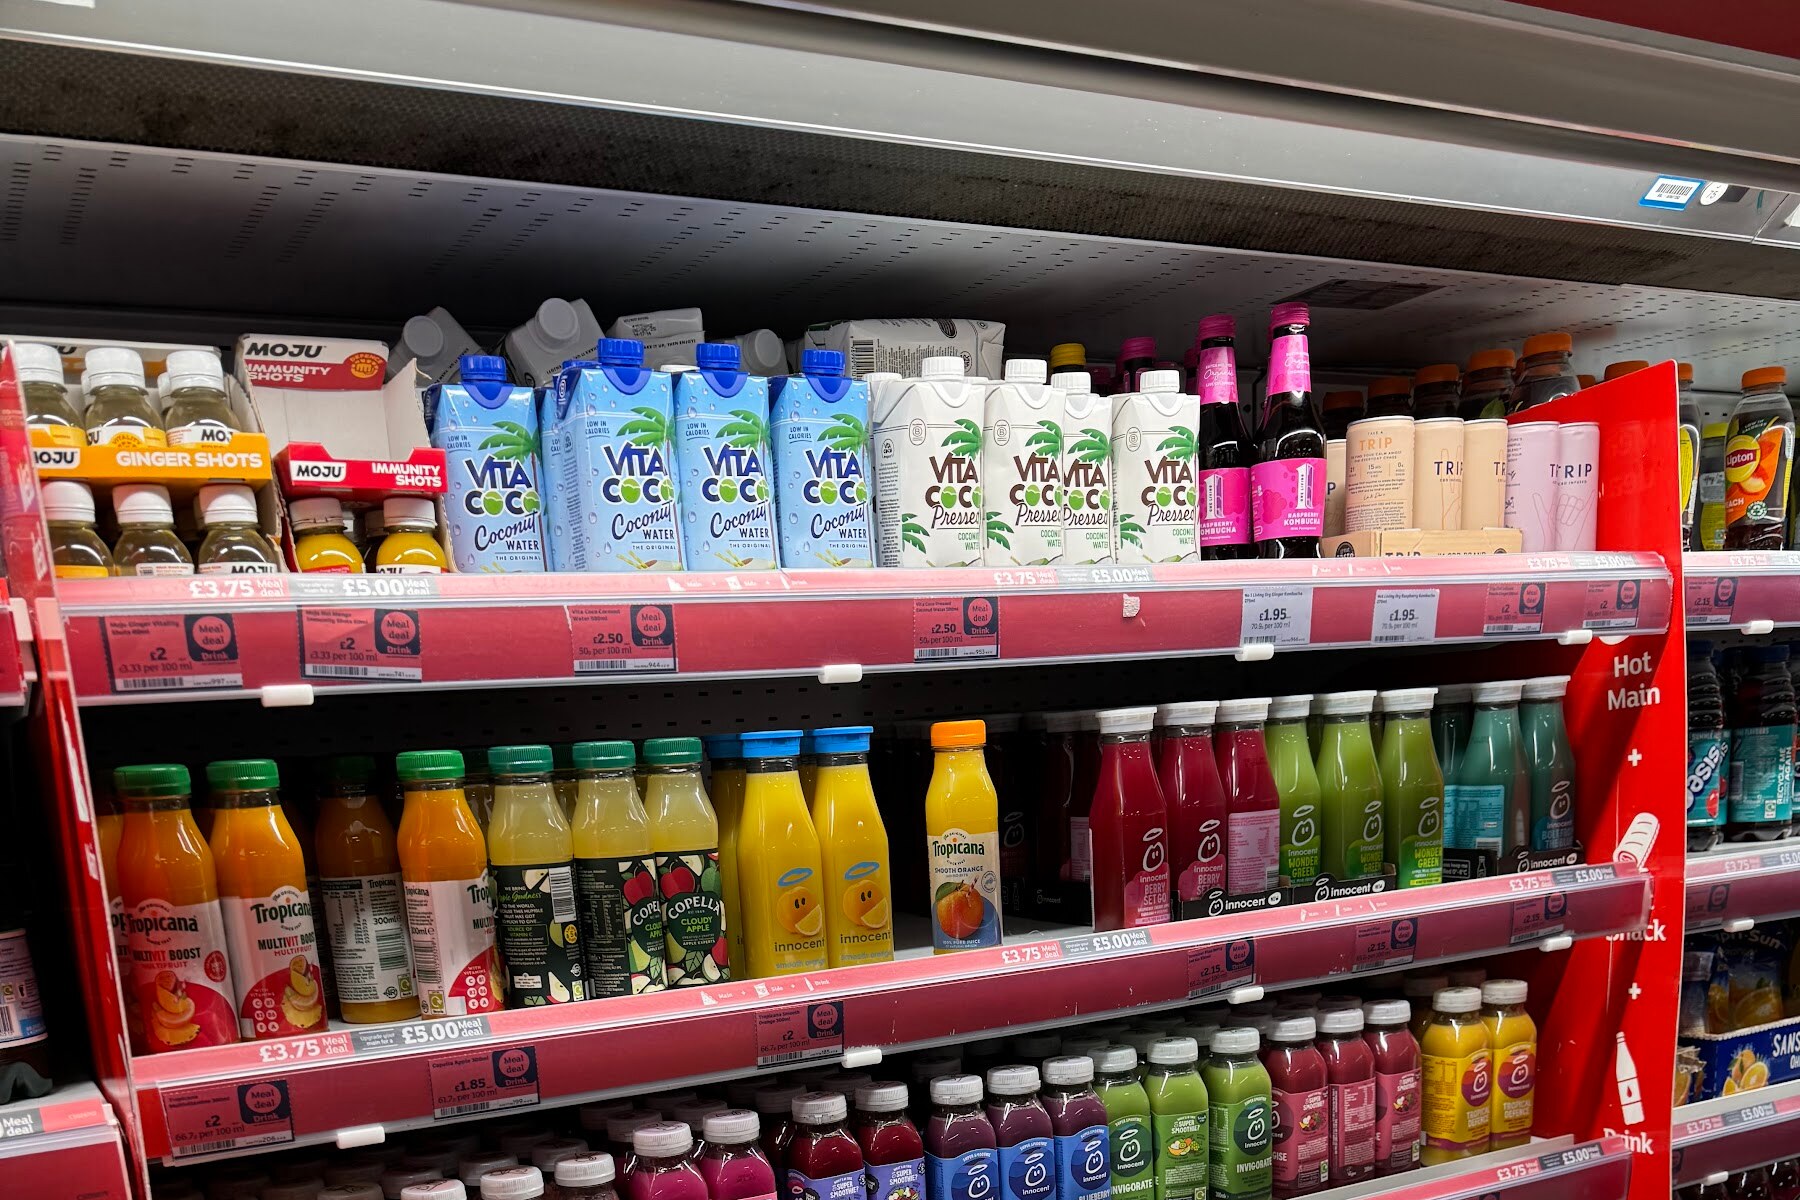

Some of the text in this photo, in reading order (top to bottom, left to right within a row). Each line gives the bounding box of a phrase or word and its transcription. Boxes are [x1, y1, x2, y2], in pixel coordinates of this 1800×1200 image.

[245, 342, 325, 359] MOJU
[349, 352, 383, 365] DEFENCE
[245, 364, 331, 377] IMMUNITY
[247, 373, 305, 383] SHOTS
[585, 426, 610, 434] CALORIES
[1359, 437, 1392, 451] TRIP
[116, 451, 263, 468] GINGER SHOTS
[603, 443, 666, 476] VITA
[701, 443, 763, 477] VITA
[1726, 451, 1754, 467] Lipton
[296, 465, 343, 479] MOJU
[372, 463, 441, 476] IMMUNITY
[463, 455, 531, 489] VITA
[929, 453, 979, 483] VITA
[1144, 456, 1194, 485] VITA
[1557, 463, 1592, 478] RIP
[395, 474, 442, 487] SHOTS
[601, 478, 674, 504] COCO
[701, 478, 769, 503] COCO
[925, 485, 982, 509] COCO
[464, 490, 541, 517] COCO
[612, 502, 673, 540] Coconut
[710, 501, 767, 537] Coconut
[1284, 518, 1321, 527] KOMBUCHA
[474, 511, 537, 552] Coconut
[643, 529, 674, 540] WATER
[739, 527, 769, 538] WATER
[506, 539, 539, 551] WATER
[189, 580, 254, 598] £3.75
[256, 579, 284, 589] Meal
[342, 579, 403, 597] £5.00
[259, 587, 284, 597] deal
[641, 612, 661, 622] Meal
[1259, 608, 1288, 622] £1.95
[1389, 609, 1415, 622] £1.95
[198, 624, 224, 635] Meal
[643, 623, 661, 632] deal
[202, 636, 225, 646] deal
[593, 633, 623, 644] £2.50
[149, 647, 167, 661] £2
[1613, 651, 1652, 676] Hot
[1607, 686, 1661, 711] Main
[1784, 747, 1792, 780] AGAIN
[1776, 746, 1785, 805] RECYCLE ME
[933, 840, 984, 857] Tropicana
[1288, 856, 1319, 868] WONDER
[1140, 873, 1168, 882] innocent
[1292, 865, 1316, 876] GREEN
[1145, 882, 1166, 894] BERRY
[1330, 883, 1371, 897] innocent
[1143, 893, 1167, 905] SET GO
[1225, 897, 1265, 911] innocent
[250, 900, 313, 925] Tropicana
[668, 895, 720, 920] COPELLA
[127, 914, 198, 935] Tropicana
[373, 915, 396, 926] 300ml
[680, 915, 713, 927] CLOUDY
[686, 923, 710, 933] APPLE
[257, 935, 298, 952] MULTIVIT
[840, 930, 891, 945] innocent
[1093, 935, 1131, 951] £5.00
[274, 945, 312, 958] MULTIFRUIT
[774, 939, 824, 953] innocent
[169, 947, 201, 961] BOOST
[1002, 948, 1041, 964] £3.75
[771, 985, 784, 993] Side
[815, 978, 830, 986] Drink
[718, 992, 733, 1000] Main
[401, 1023, 459, 1044] £5.00
[782, 1030, 794, 1041] £2
[322, 1035, 348, 1047] Meal
[1772, 1035, 1800, 1060] SANS
[259, 1039, 321, 1062] £3.75
[326, 1044, 349, 1055] deal
[454, 1078, 486, 1092] £1.85
[205, 1115, 221, 1127] £2
[1117, 1160, 1144, 1170] innocent
[1237, 1158, 1272, 1173] INVIGORATE
